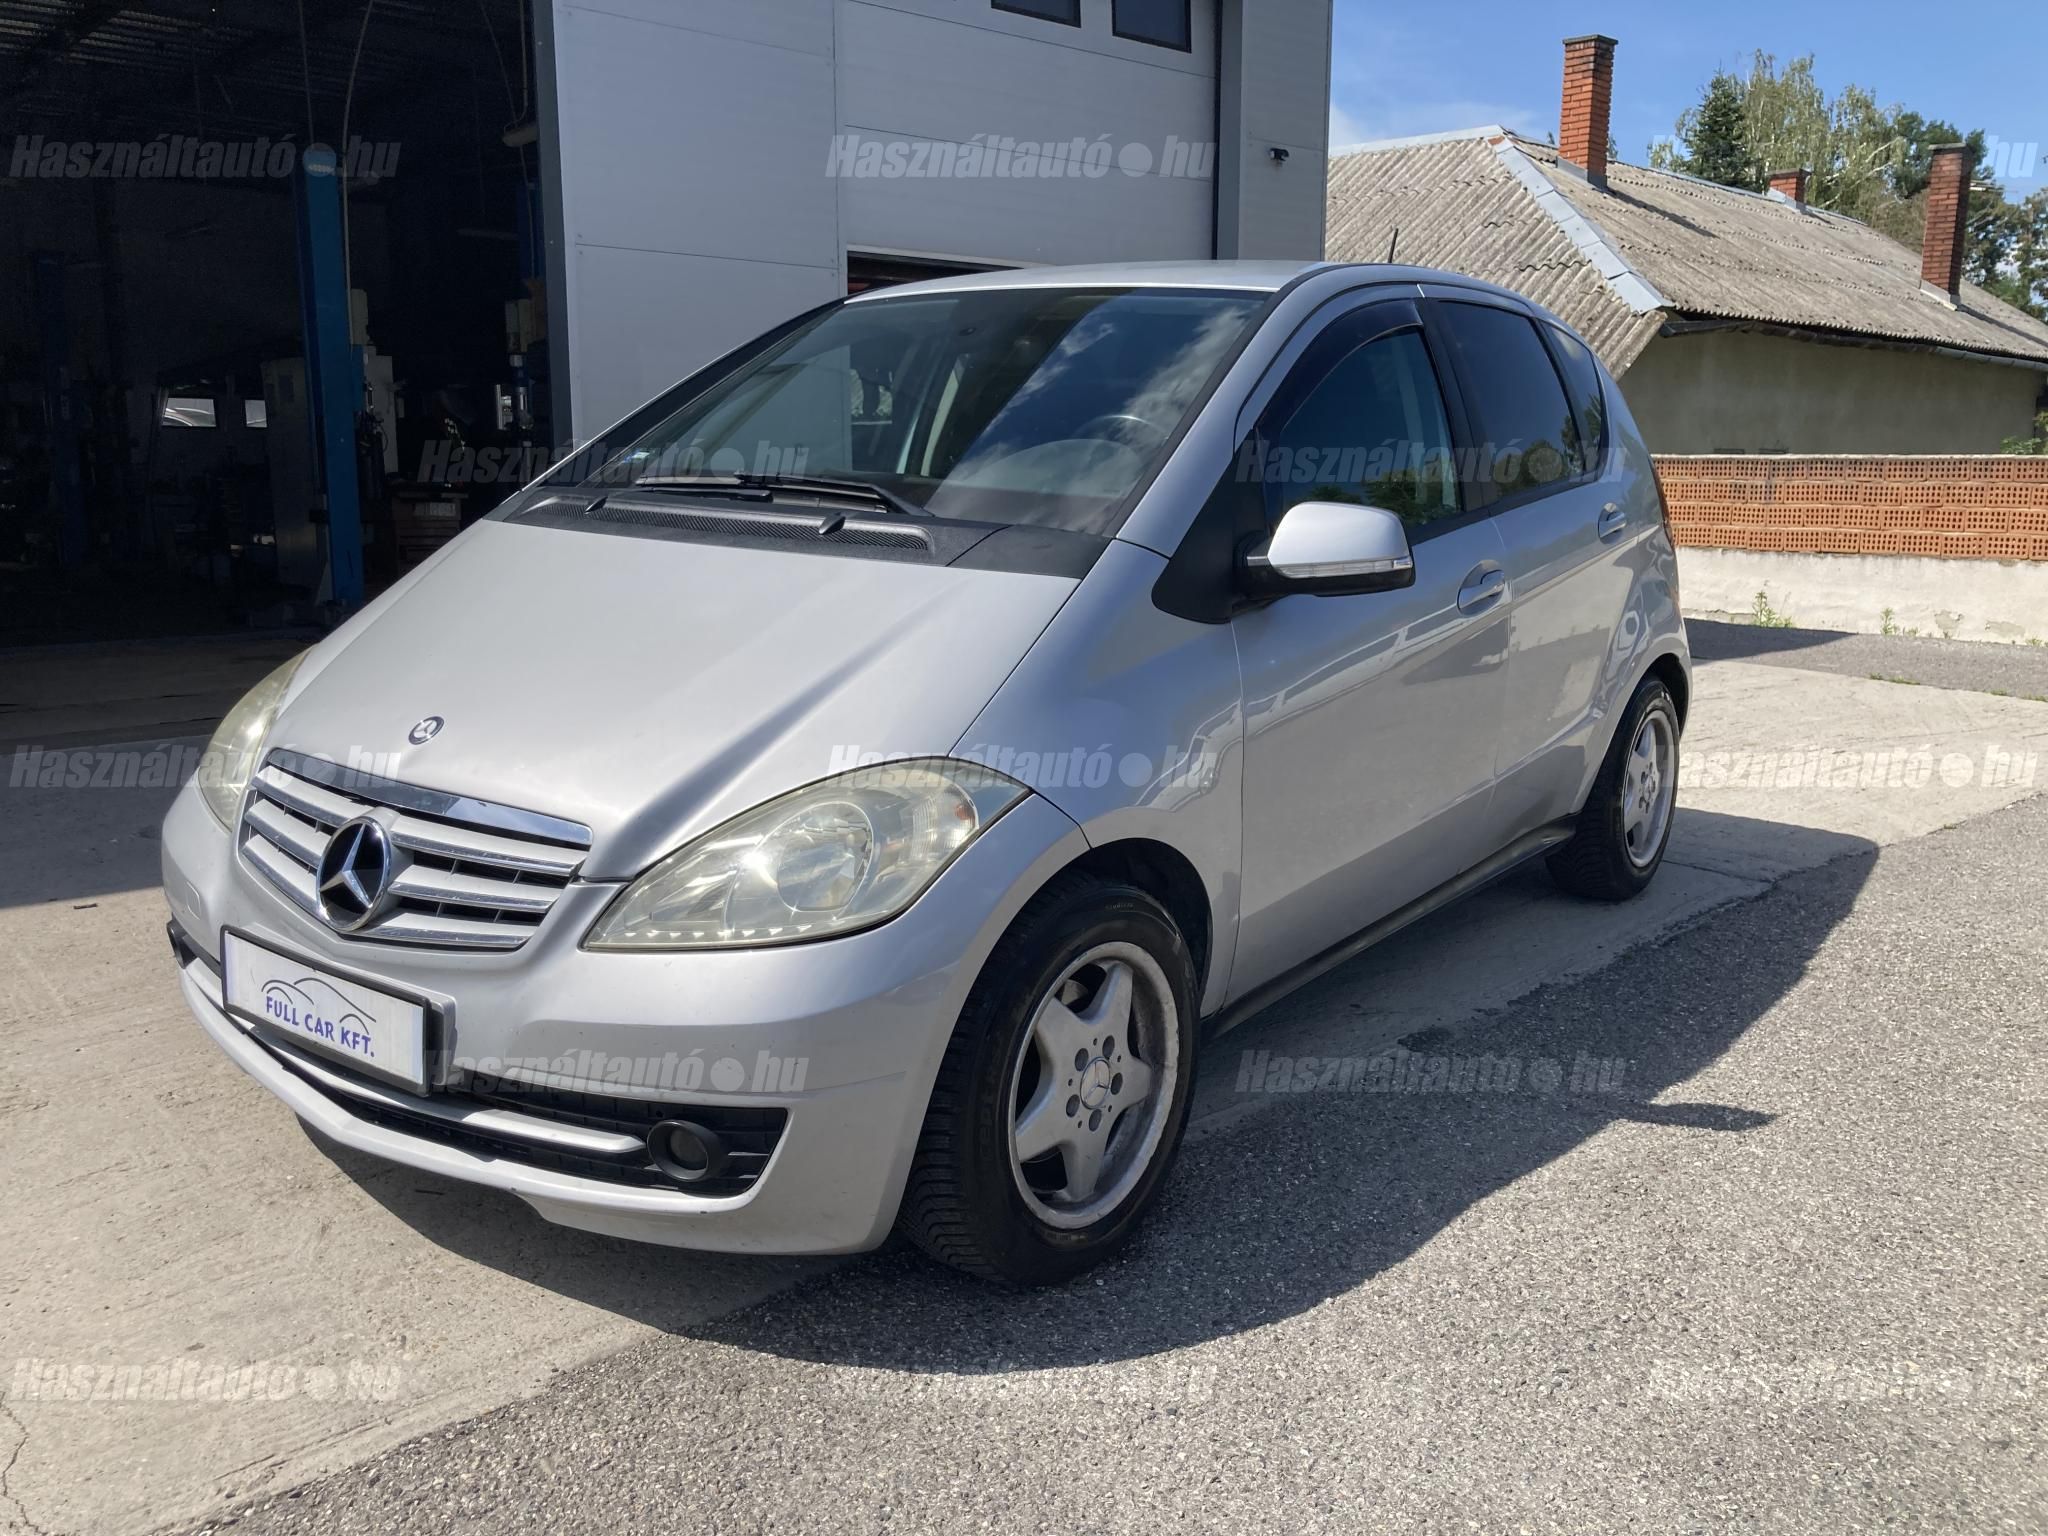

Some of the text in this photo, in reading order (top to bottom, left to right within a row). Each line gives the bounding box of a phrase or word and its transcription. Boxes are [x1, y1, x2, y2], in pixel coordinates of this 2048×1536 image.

[266, 995, 374, 1057] FULL CAR KFT.
